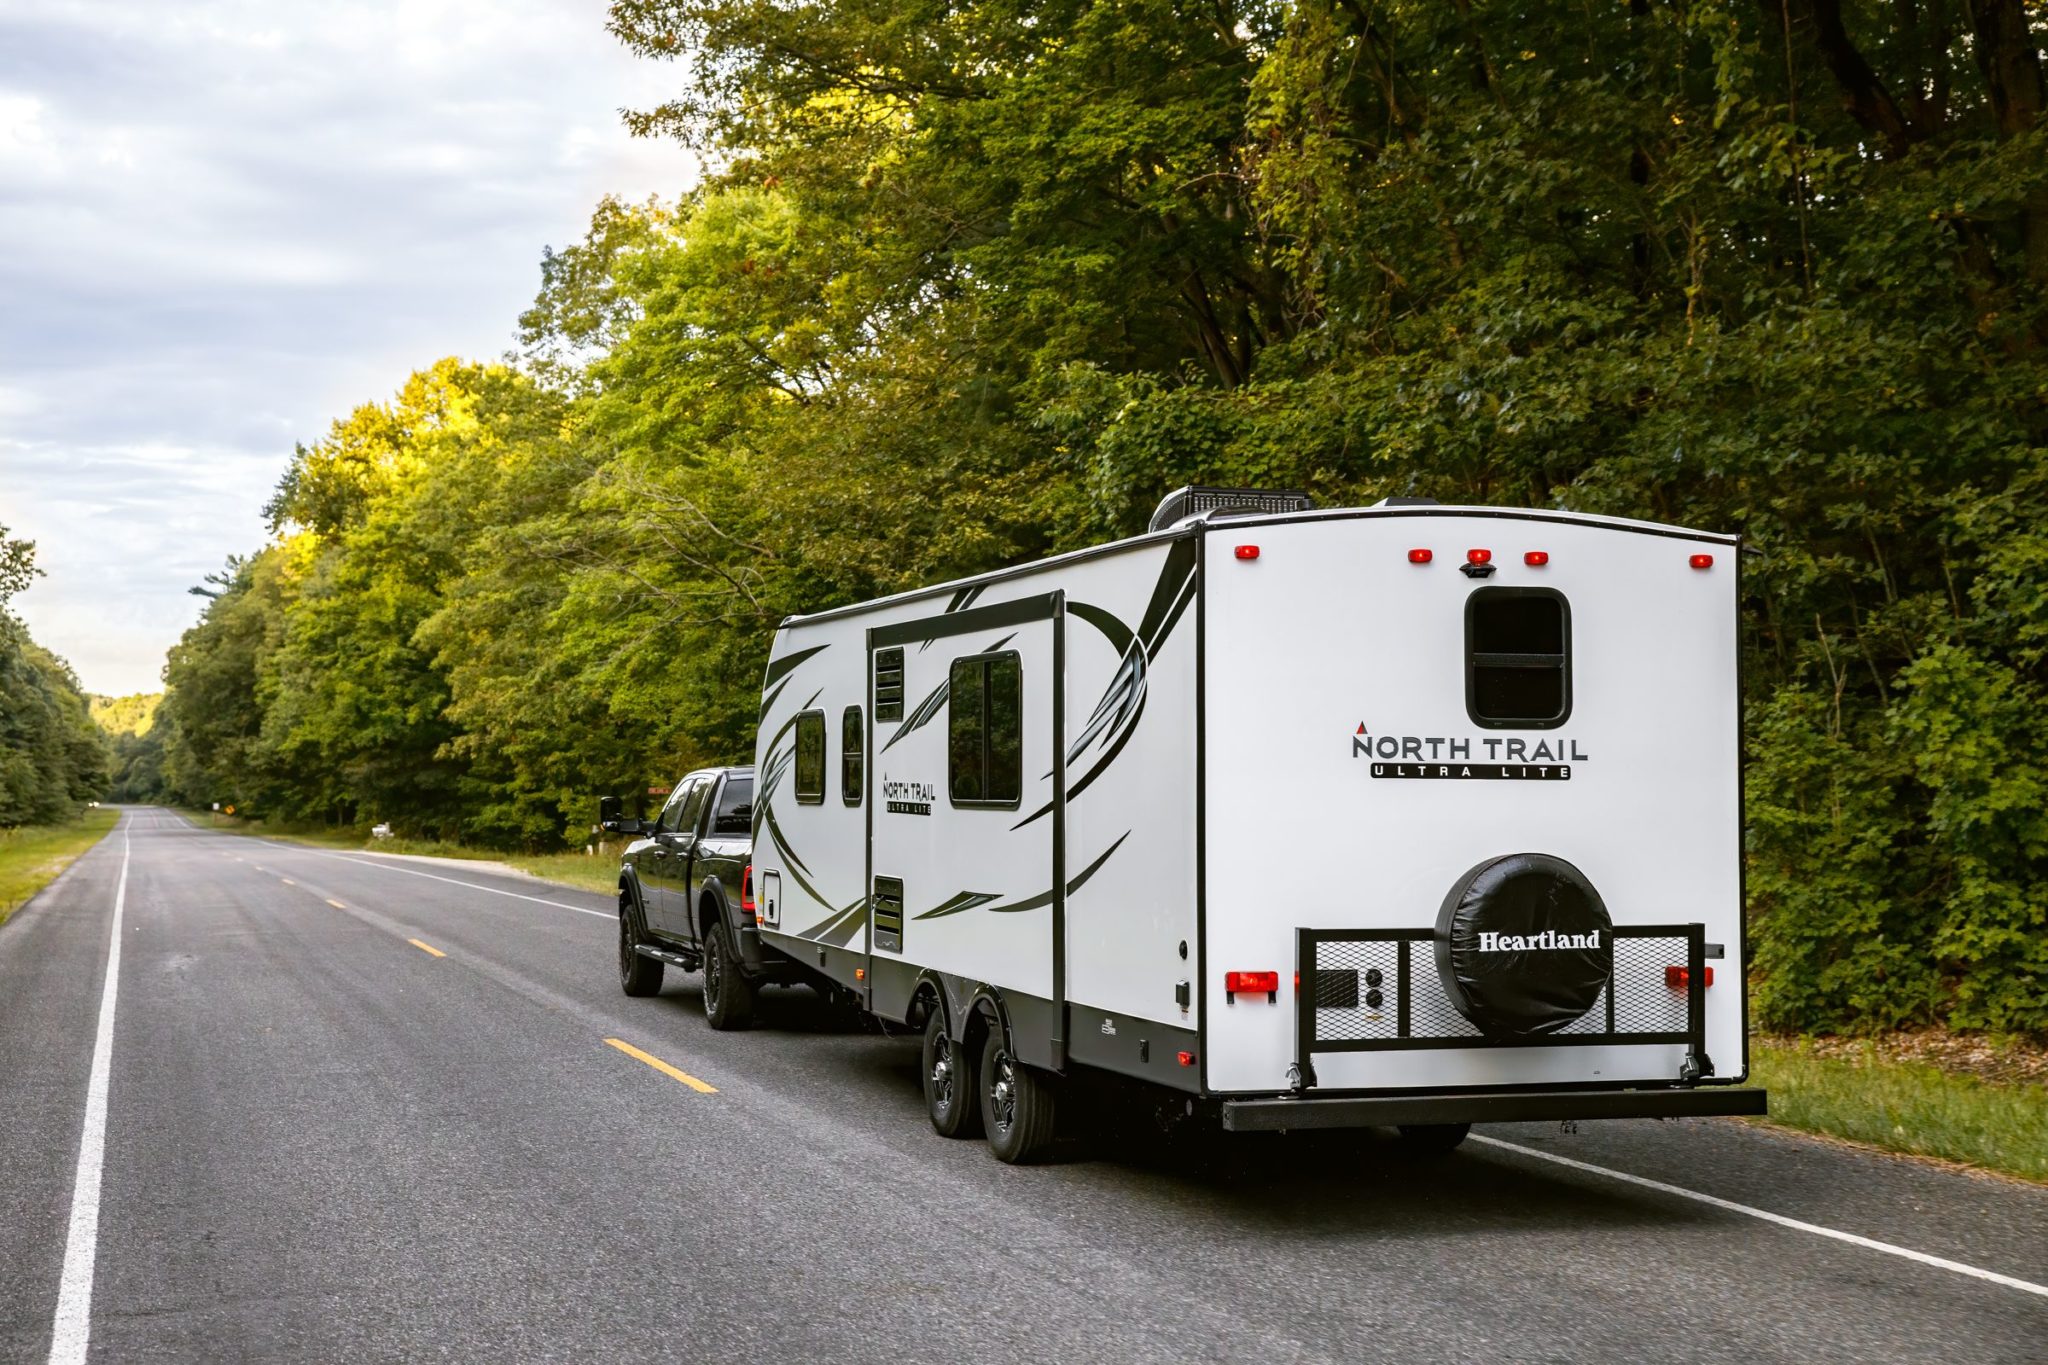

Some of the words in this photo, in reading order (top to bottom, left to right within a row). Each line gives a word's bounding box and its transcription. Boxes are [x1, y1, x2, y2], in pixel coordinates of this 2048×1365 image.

[1352, 735, 1470, 761] NORTH
[1483, 738, 1588, 762] TRAIL
[1374, 765, 1472, 777] ULTRA
[1501, 766, 1569, 778] LITE
[883, 782, 909, 800] NORTH
[911, 783, 936, 801] TRAIL
[887, 803, 910, 812] ULTRA
[914, 804, 931, 814] LITE
[1478, 929, 1601, 952] Heartland
